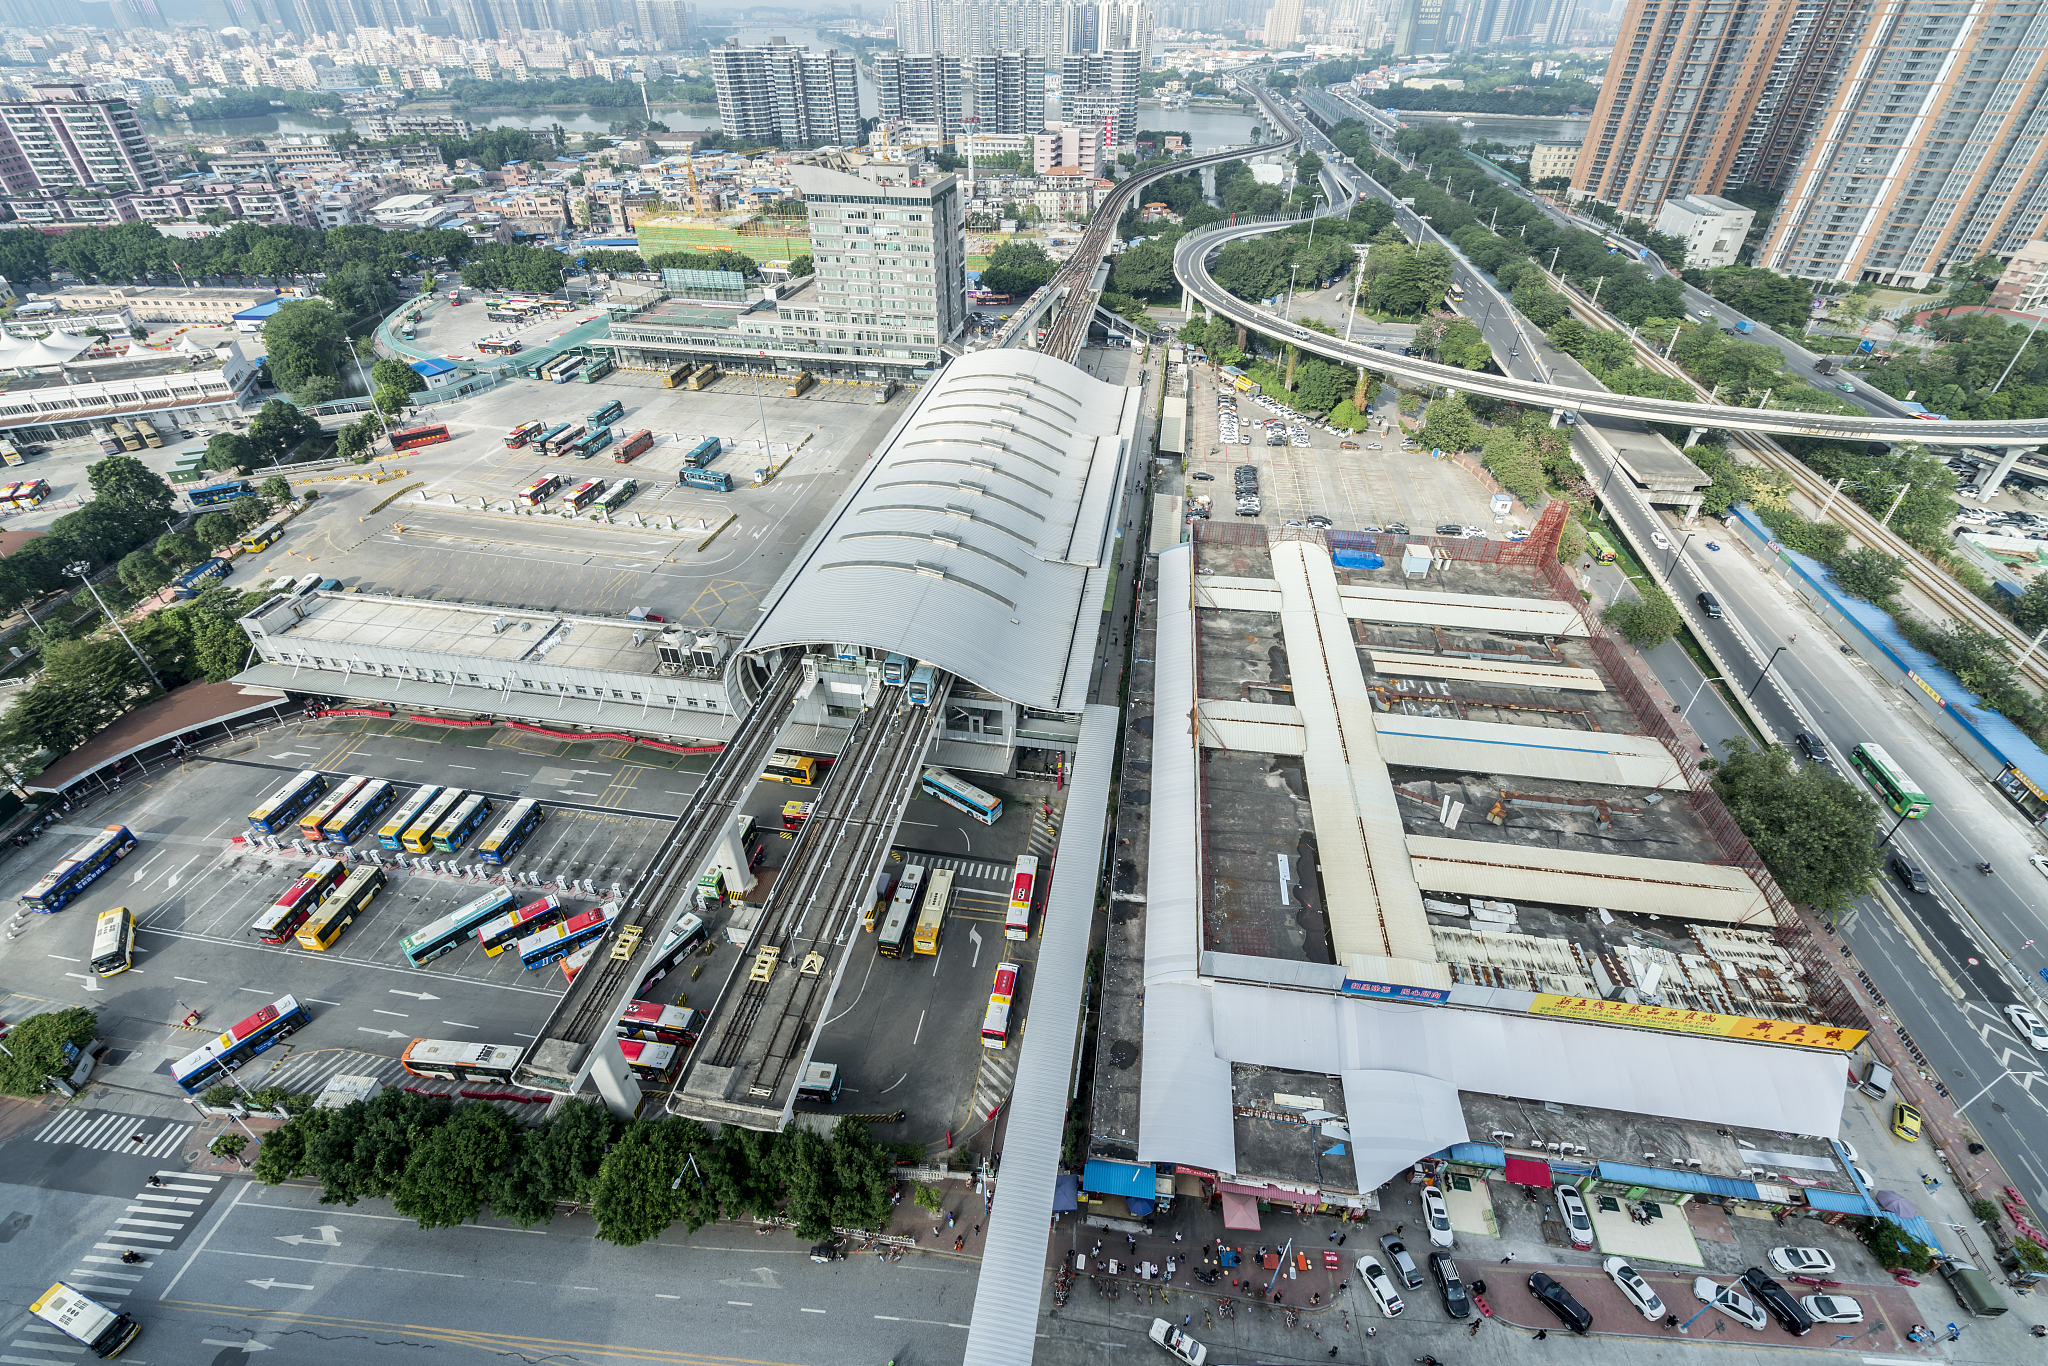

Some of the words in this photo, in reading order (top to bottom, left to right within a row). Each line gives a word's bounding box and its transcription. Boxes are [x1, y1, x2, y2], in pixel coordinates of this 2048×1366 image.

[1351, 982, 1392, 993] 扫黑除恶
[1400, 989, 1442, 999] 民心所向
[1622, 1011, 1648, 1019] CRAFTS
[1651, 1015, 1694, 1024] WHOLESALE
